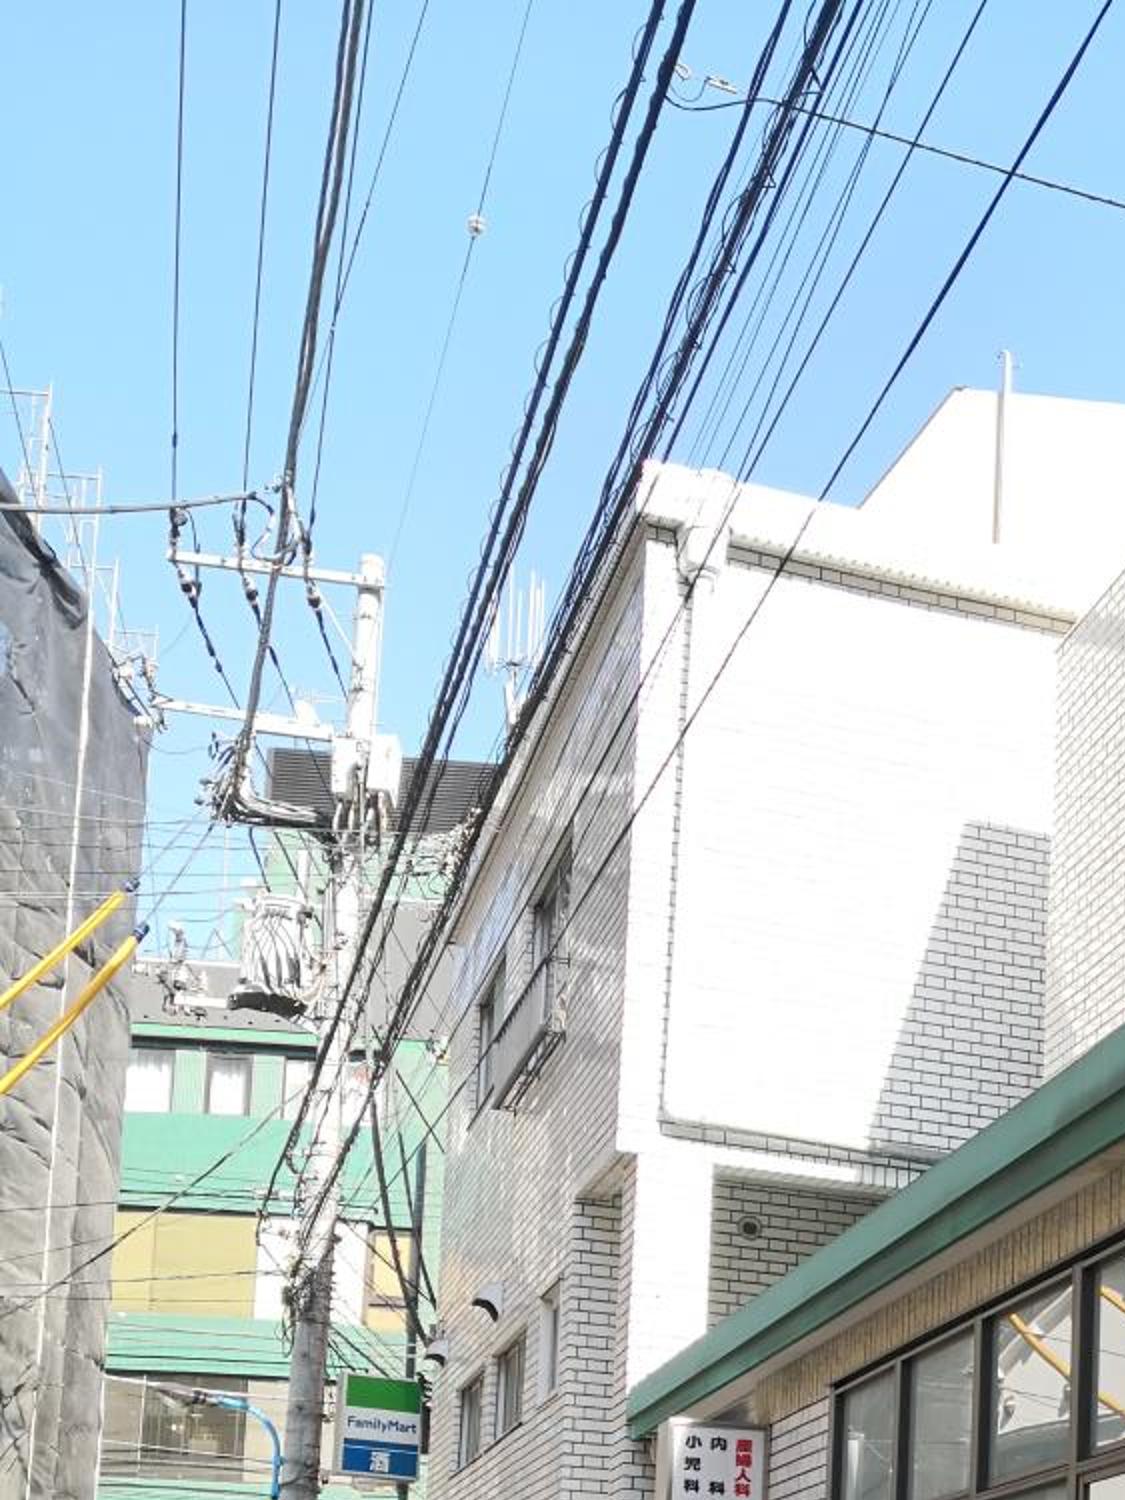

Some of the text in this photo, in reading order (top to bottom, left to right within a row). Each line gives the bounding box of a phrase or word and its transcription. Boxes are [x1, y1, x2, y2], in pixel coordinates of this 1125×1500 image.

[347, 1415, 417, 1434] FamilyMart
[683, 1435, 703, 1494] 小児科
[708, 1436, 728, 1496] 内科
